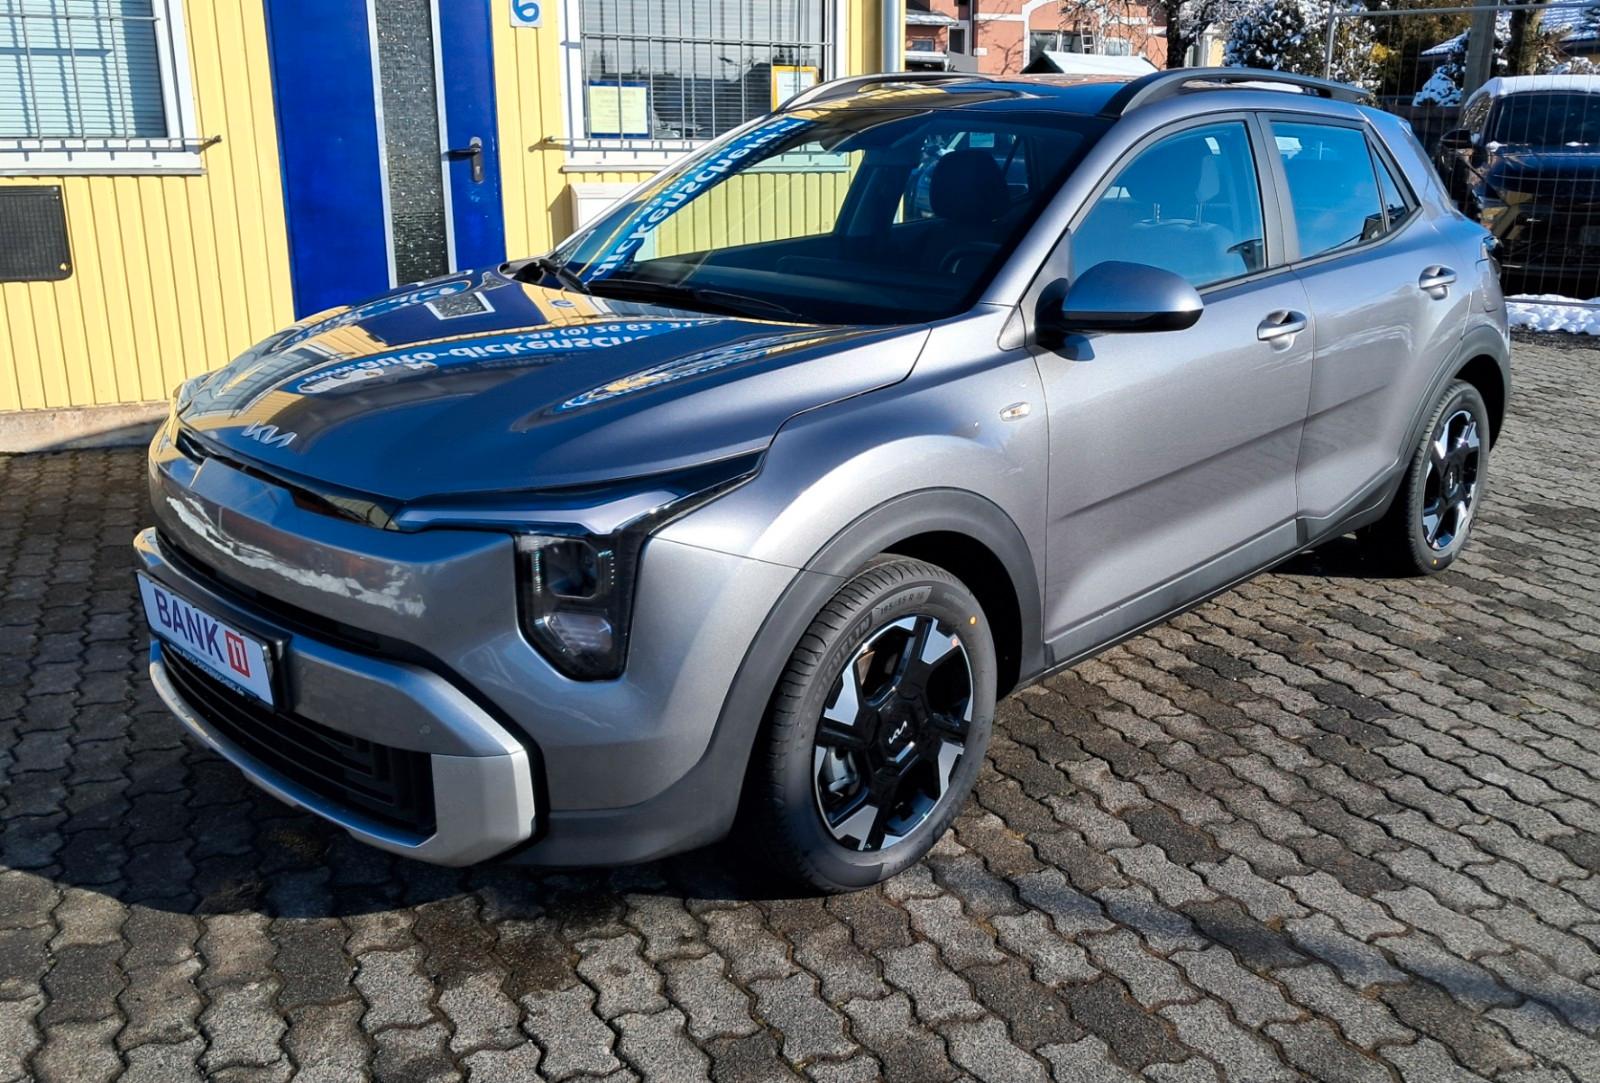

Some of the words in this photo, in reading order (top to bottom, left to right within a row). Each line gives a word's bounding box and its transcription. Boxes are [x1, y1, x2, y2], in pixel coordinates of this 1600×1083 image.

[512, 0, 539, 22] 6
[241, 420, 297, 448] KIA
[154, 588, 226, 664] BANK
[888, 720, 908, 744] KIA
